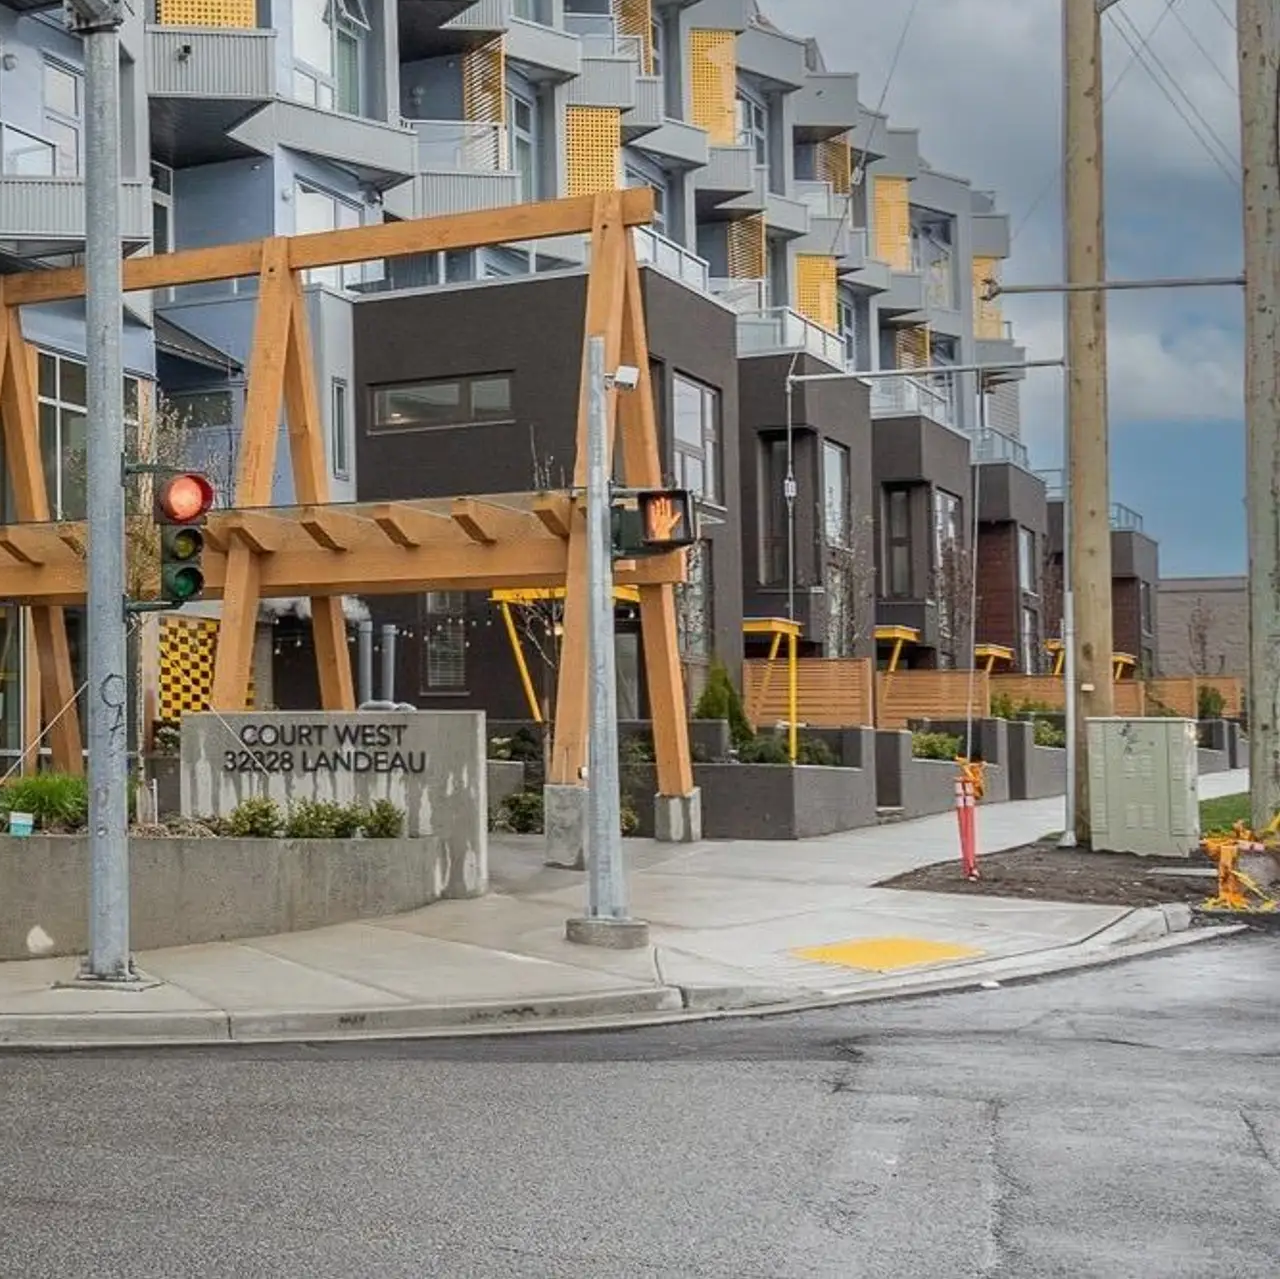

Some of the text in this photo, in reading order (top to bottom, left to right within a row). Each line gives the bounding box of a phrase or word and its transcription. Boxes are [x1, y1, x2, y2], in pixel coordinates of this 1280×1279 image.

[240, 724, 408, 747] COURT WEST
[223, 751, 426, 773] 32828 LANDEAU
